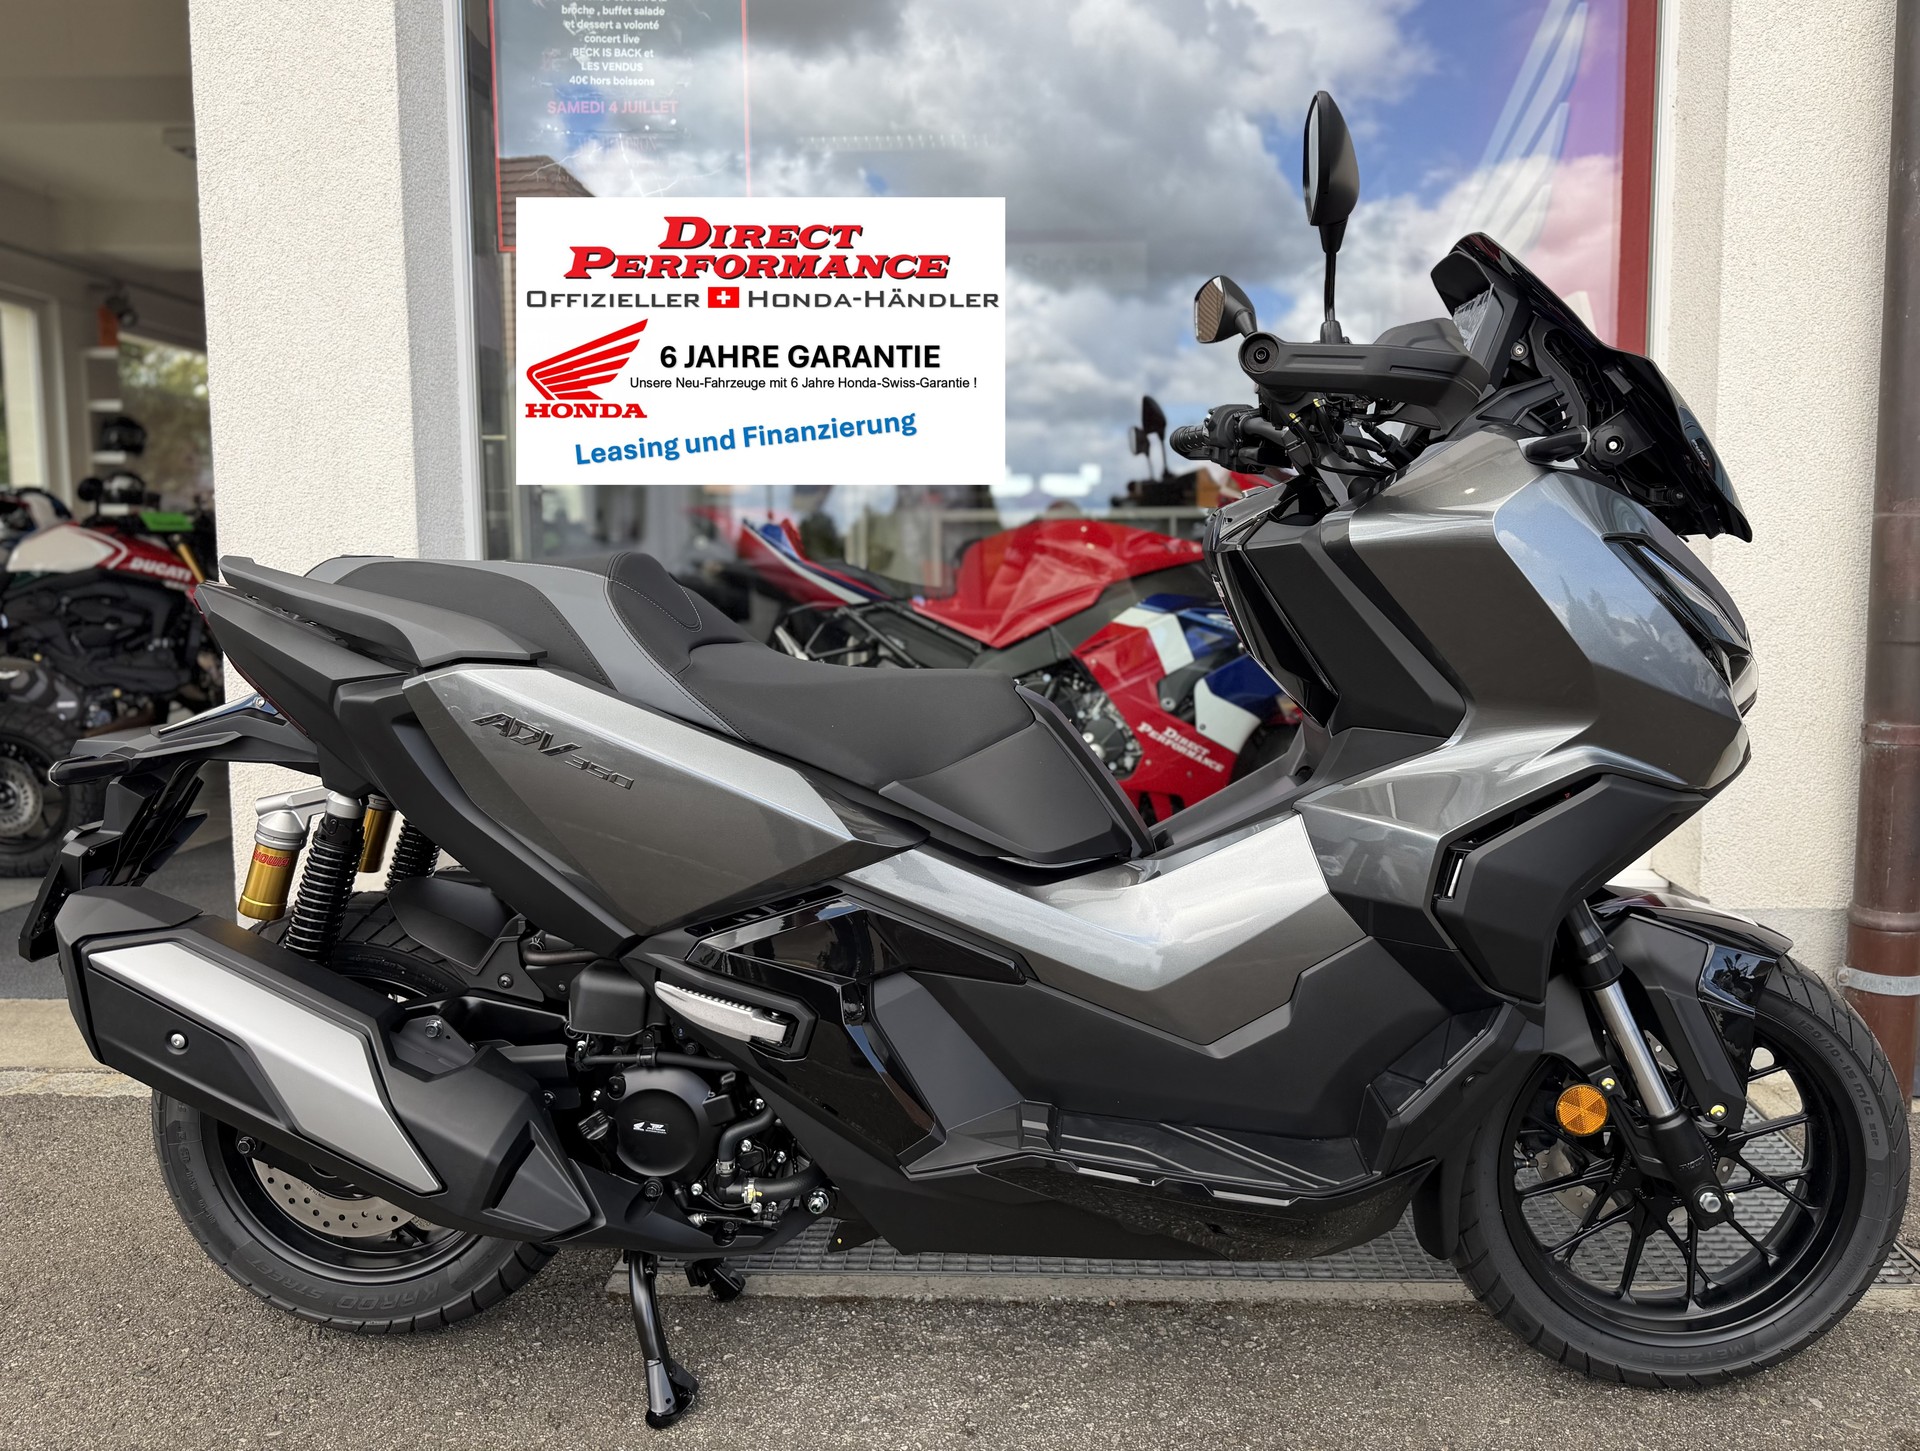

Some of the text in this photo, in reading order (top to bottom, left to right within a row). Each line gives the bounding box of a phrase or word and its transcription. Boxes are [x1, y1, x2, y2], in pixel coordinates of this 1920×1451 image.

[561, 5, 595, 15] broche
[602, 6, 631, 15] buffet
[634, 6, 665, 16] salade
[565, 20, 575, 28] et
[577, 20, 613, 29] dessert
[623, 20, 659, 30] volonté
[584, 35, 640, 44] concert live
[572, 47, 654, 58] BECK IS BACK et
[581, 62, 643, 72] LES VENDUS
[569, 75, 655, 86] 40€ hors boissons
[547, 101, 679, 114] SAMEDI 4 JUILLET
[129, 556, 192, 581] DUCATI
[1162, 726, 1210, 755] DIRECT
[470, 712, 635, 790] ADV 350
[1136, 721, 1225, 773] PERFORMANCE
[249, 1258, 326, 1299] STREET
